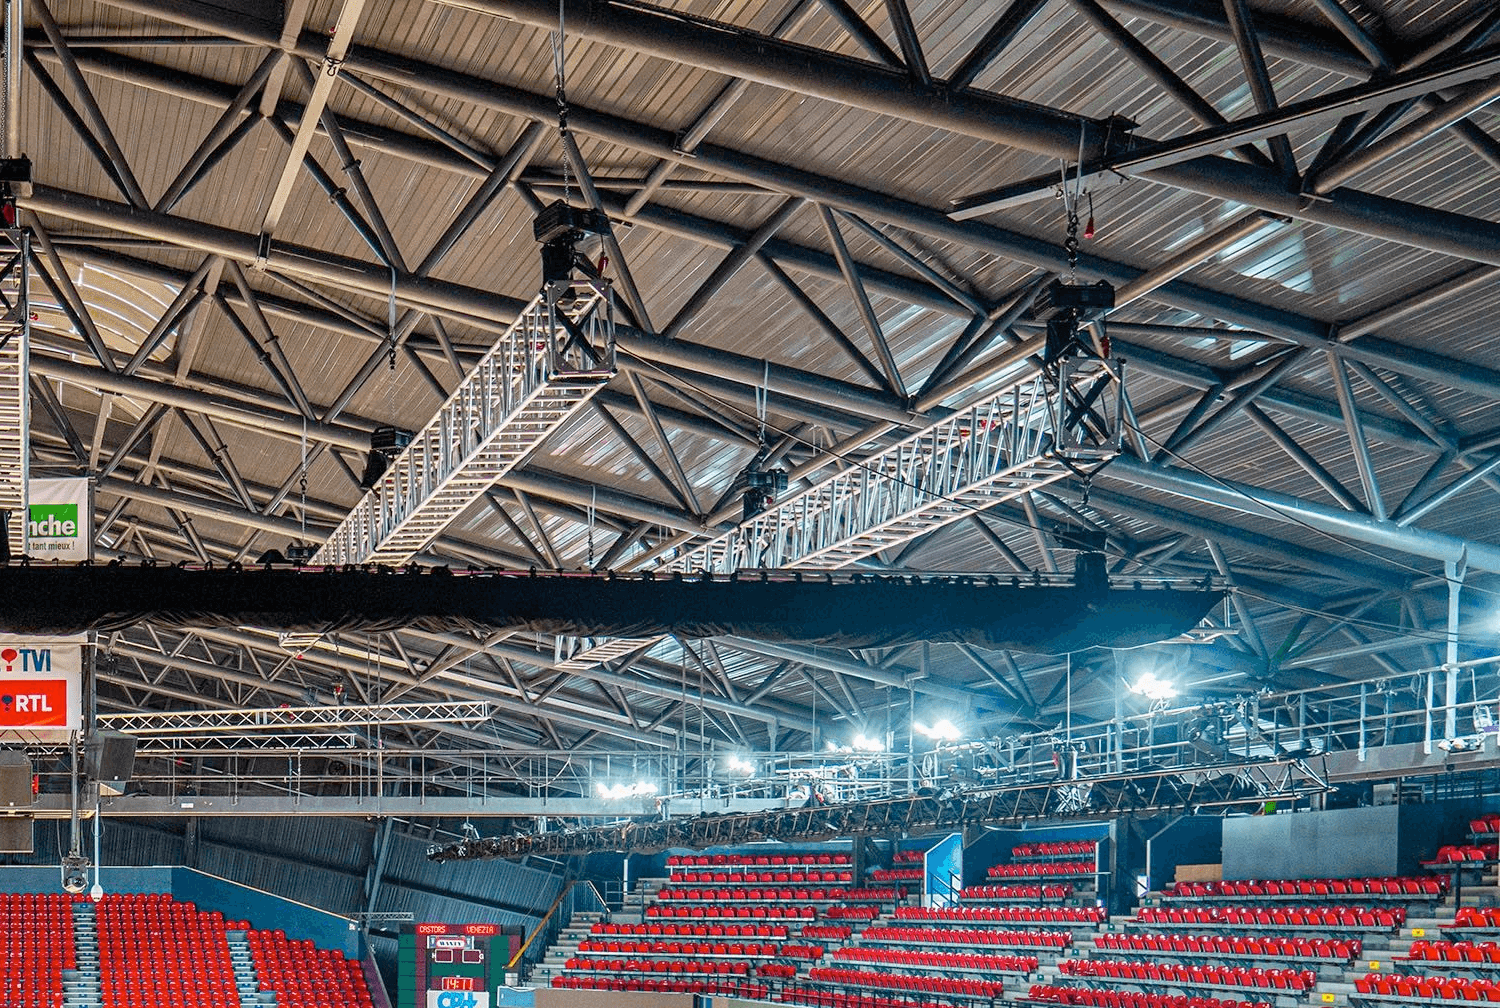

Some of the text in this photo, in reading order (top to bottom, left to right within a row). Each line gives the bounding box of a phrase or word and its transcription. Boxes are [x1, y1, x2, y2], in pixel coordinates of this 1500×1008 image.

[33, 541, 46, 550] tant
[48, 541, 70, 550] mieux
[19, 649, 51, 672] TVI
[15, 695, 52, 713] RTL
[466, 925, 494, 934] VENEZIA
